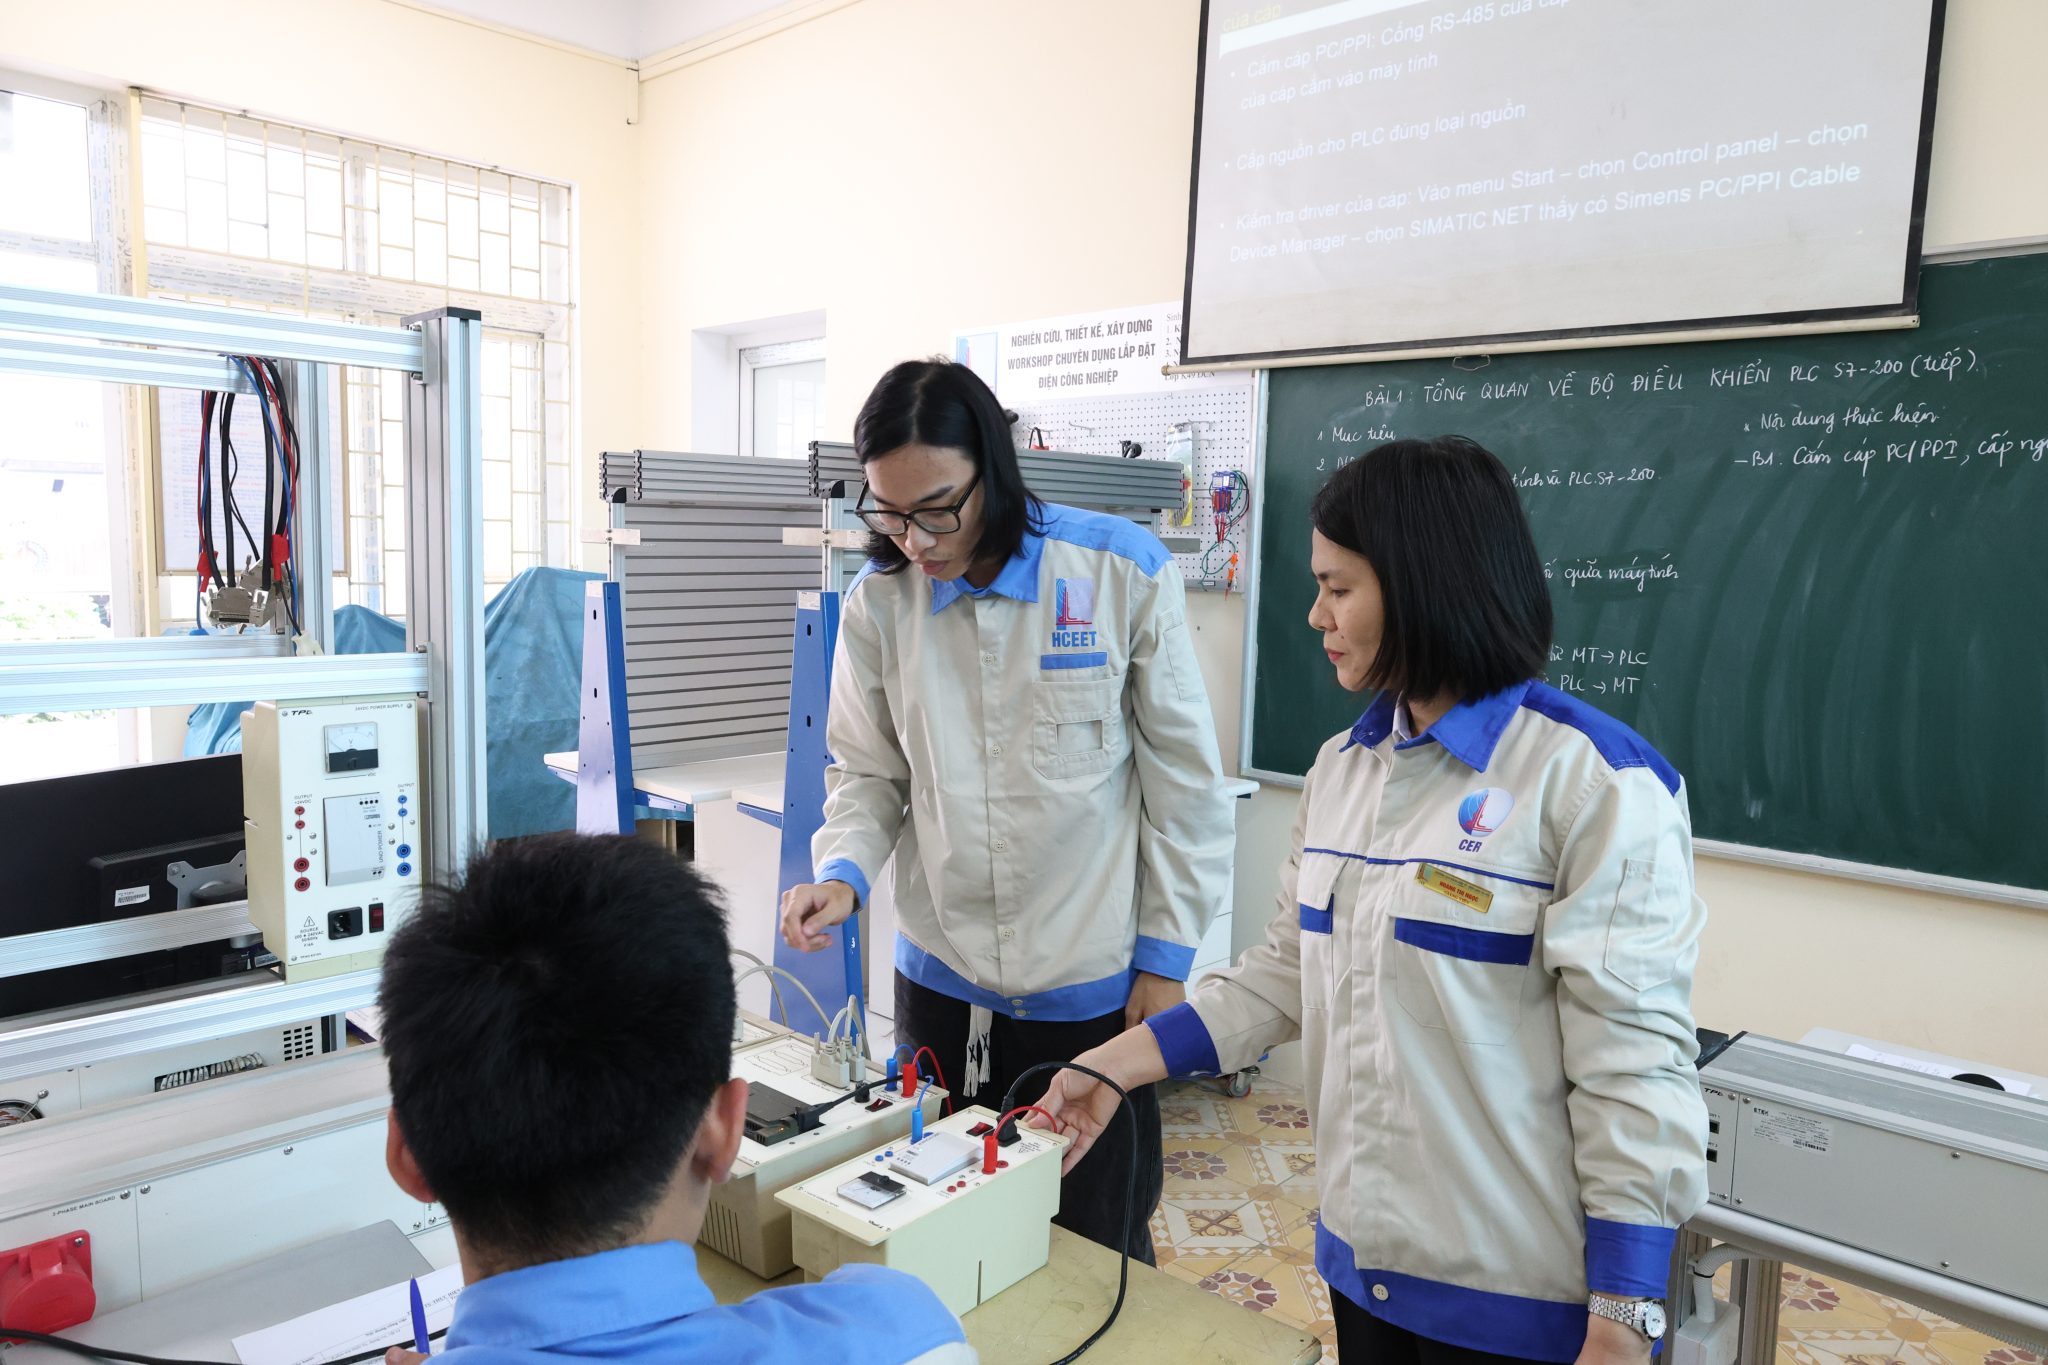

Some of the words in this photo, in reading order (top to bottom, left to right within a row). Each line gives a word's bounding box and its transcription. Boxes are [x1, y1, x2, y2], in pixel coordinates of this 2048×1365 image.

[1381, 20, 1424, 43] Cổng
[1430, 2, 1495, 34] RS-485
[1239, 88, 1265, 110] của
[1270, 84, 1296, 103] cáp
[1369, 61, 1403, 81] máy
[1408, 52, 1439, 72] tính
[1269, 138, 1313, 166] nguồn
[1318, 137, 1346, 155] cho
[1350, 127, 1385, 149] PLC
[1389, 122, 1430, 139] đúng
[1434, 111, 1464, 134] loại
[1470, 97, 1526, 129] nguồn
[1276, 210, 1294, 225] tra
[1298, 201, 1341, 222] driver
[1345, 194, 1373, 214] của
[1417, 184, 1450, 202] Vào
[1456, 177, 1505, 197] menu
[1511, 168, 1555, 189] Start
[1578, 160, 1625, 179] chọn
[1633, 142, 1709, 170] Control
[1715, 131, 1779, 164] panel
[1808, 122, 1869, 146] chọn
[1230, 243, 1278, 263] Device
[1281, 233, 1347, 254] Manager
[1365, 226, 1405, 244] chọn
[1409, 210, 1487, 238] SIMATIC
[1492, 203, 1535, 227] NET
[1539, 194, 1580, 222] thấy
[1584, 194, 1609, 214] có
[1614, 187, 1692, 211] Simens
[1699, 171, 1781, 200] PC/PPI
[1789, 162, 1861, 189] Cable
[1011, 330, 1041, 347] NGHIÊN
[1065, 323, 1089, 341] THIẾT
[1107, 320, 1125, 336] XÂY
[1127, 318, 1153, 336] DỰNG
[1007, 354, 1053, 370] WORKSHOP
[1055, 348, 1089, 366] CHUYÊN
[1038, 373, 1058, 390] ĐIỆN
[1060, 371, 1083, 387] CÔNG
[1086, 368, 1119, 386] NGHIỆP
[1424, 378, 1467, 403] TỔNG
[1480, 381, 1530, 400] QUAN
[1590, 372, 1615, 400] BỘ
[1631, 364, 1684, 392] ĐIỀU
[1710, 358, 1772, 387] KHIỂN
[1790, 365, 1819, 382] PLC
[1833, 359, 1903, 379] S7-200
[1367, 424, 1397, 440] tiêu
[1792, 410, 1836, 434] dung
[1842, 406, 1884, 427] thực
[1793, 440, 1832, 465] Cắm
[1843, 437, 1877, 477] cáp
[1978, 430, 2014, 468] cấp
[1609, 556, 1645, 592] máy
[1051, 631, 1097, 648] HCEET
[1572, 647, 1600, 663] MT
[1619, 649, 1649, 666] PLC
[1560, 674, 1586, 692] PLC
[1614, 677, 1641, 694] MT
[1458, 838, 1483, 853] CER
